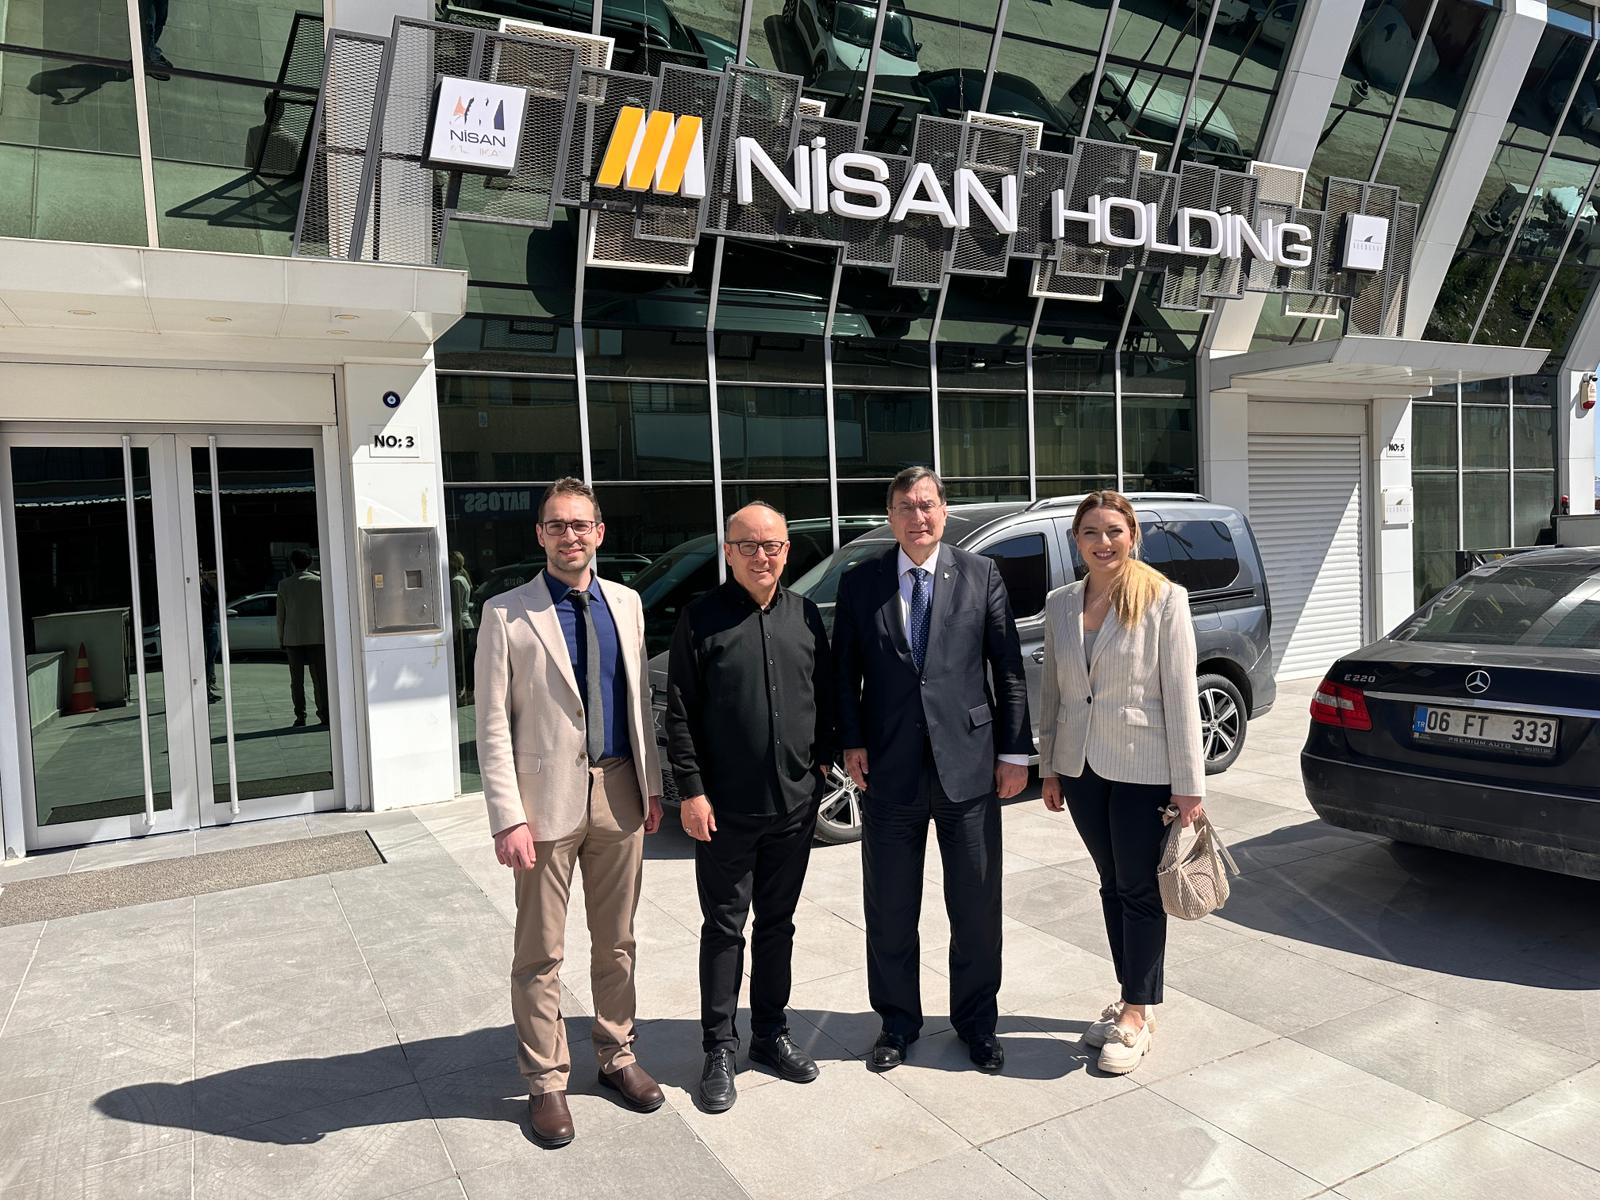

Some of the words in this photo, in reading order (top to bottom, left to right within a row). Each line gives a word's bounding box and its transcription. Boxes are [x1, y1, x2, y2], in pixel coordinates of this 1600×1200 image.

[450, 129, 506, 148] NİSAN
[735, 135, 1019, 235] NİSAN
[1051, 189, 1313, 269] HOLDİNG
[374, 435, 403, 448] NO:
[405, 436, 415, 448] 3
[1388, 443, 1399, 452] NO:
[1400, 444, 1405, 452] 5
[1416, 720, 1426, 728] TR
[1426, 710, 1451, 732] 06
[1463, 714, 1490, 737] FT
[1511, 719, 1553, 745] 333
[1448, 737, 1486, 746] PREMIUM
